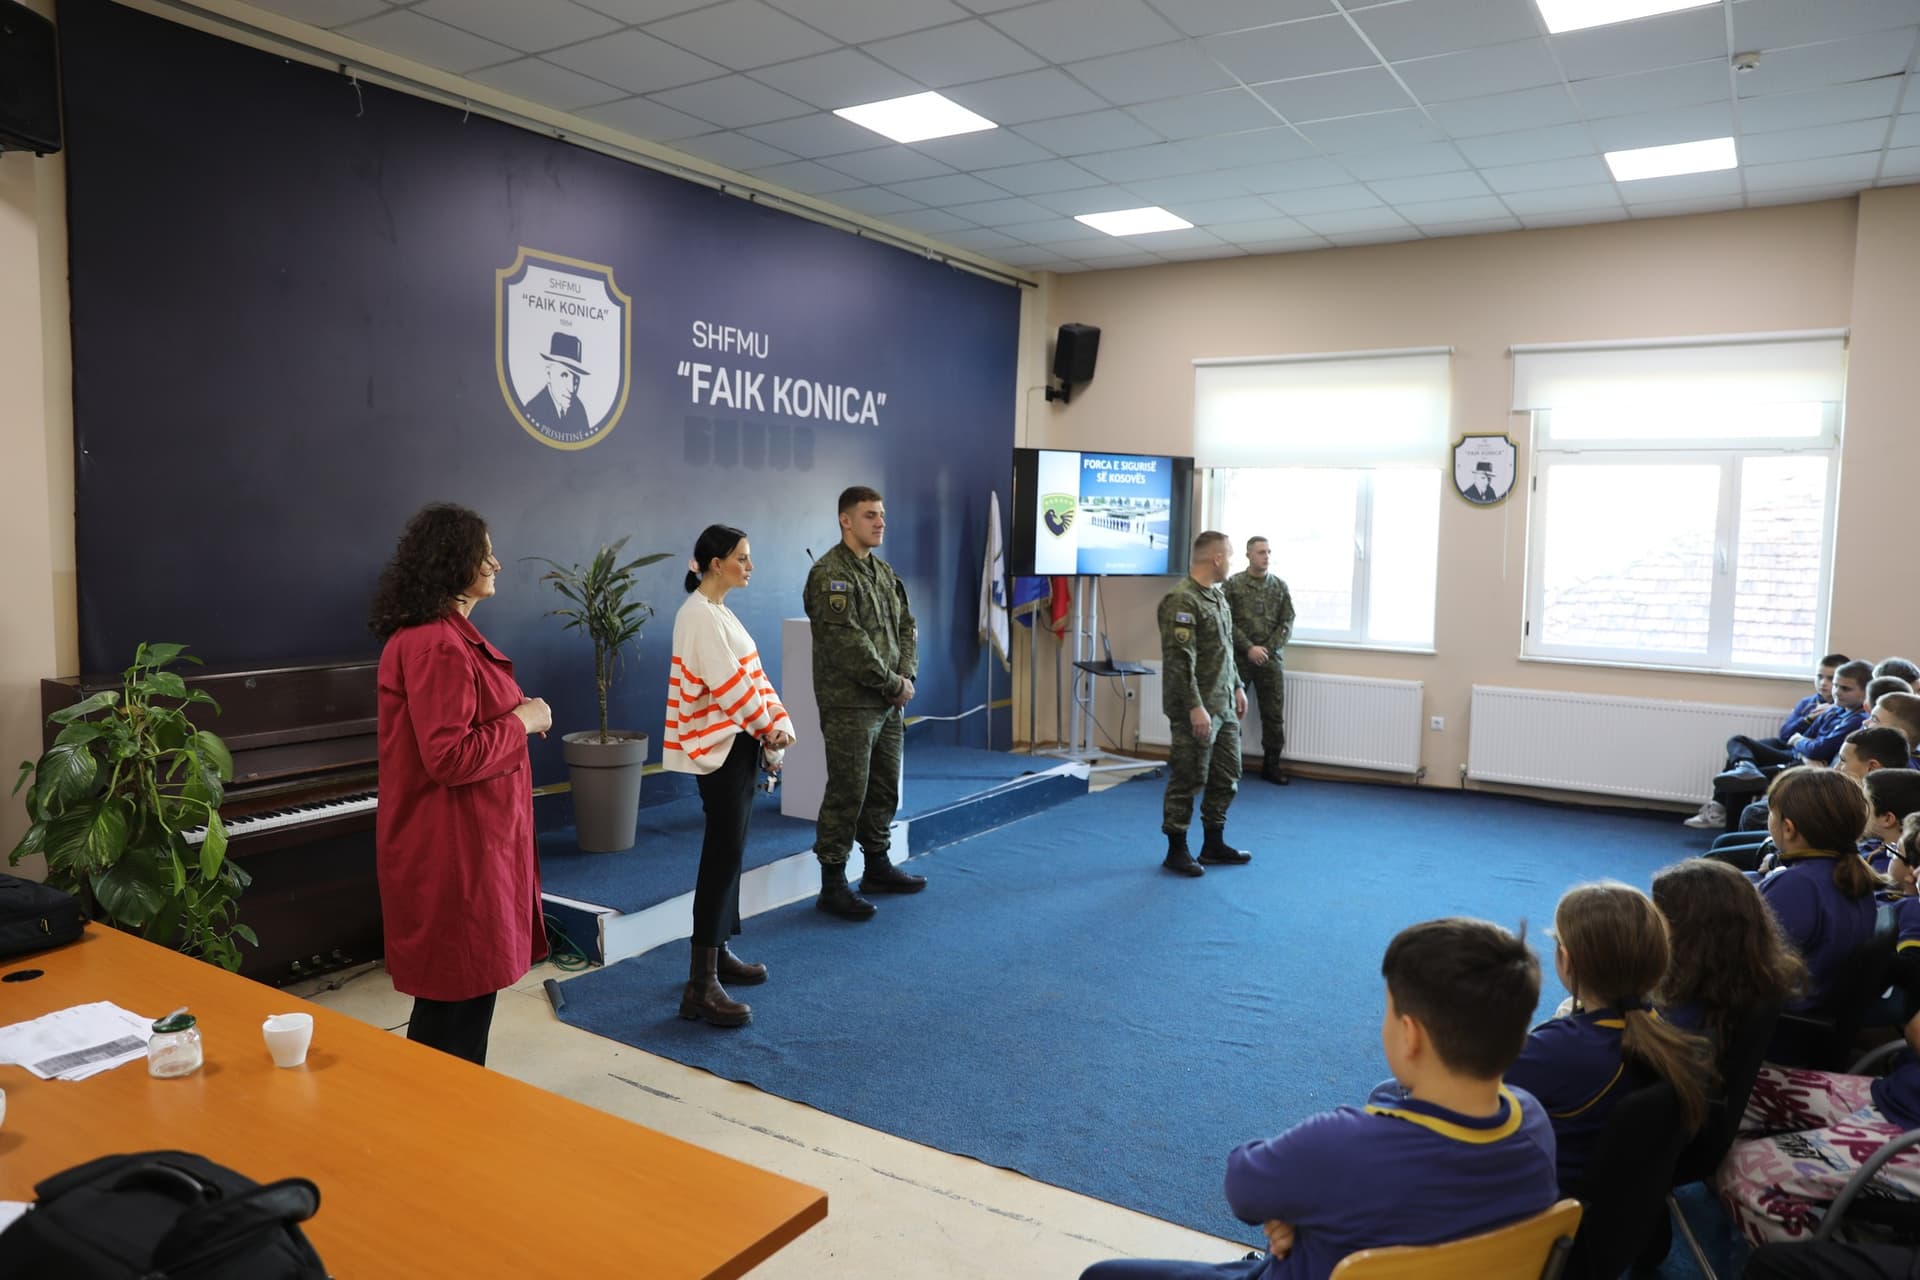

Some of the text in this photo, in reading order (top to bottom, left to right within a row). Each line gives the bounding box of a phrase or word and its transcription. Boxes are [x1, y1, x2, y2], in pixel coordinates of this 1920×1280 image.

[549, 278, 582, 294] SHFMU
[522, 293, 609, 321] “FAIK KONICA”
[692, 320, 769, 359] SHFMU
[677, 361, 888, 426] “FAIK KONICA”
[1083, 459, 1113, 470] FORCA
[1113, 460, 1120, 471] E
